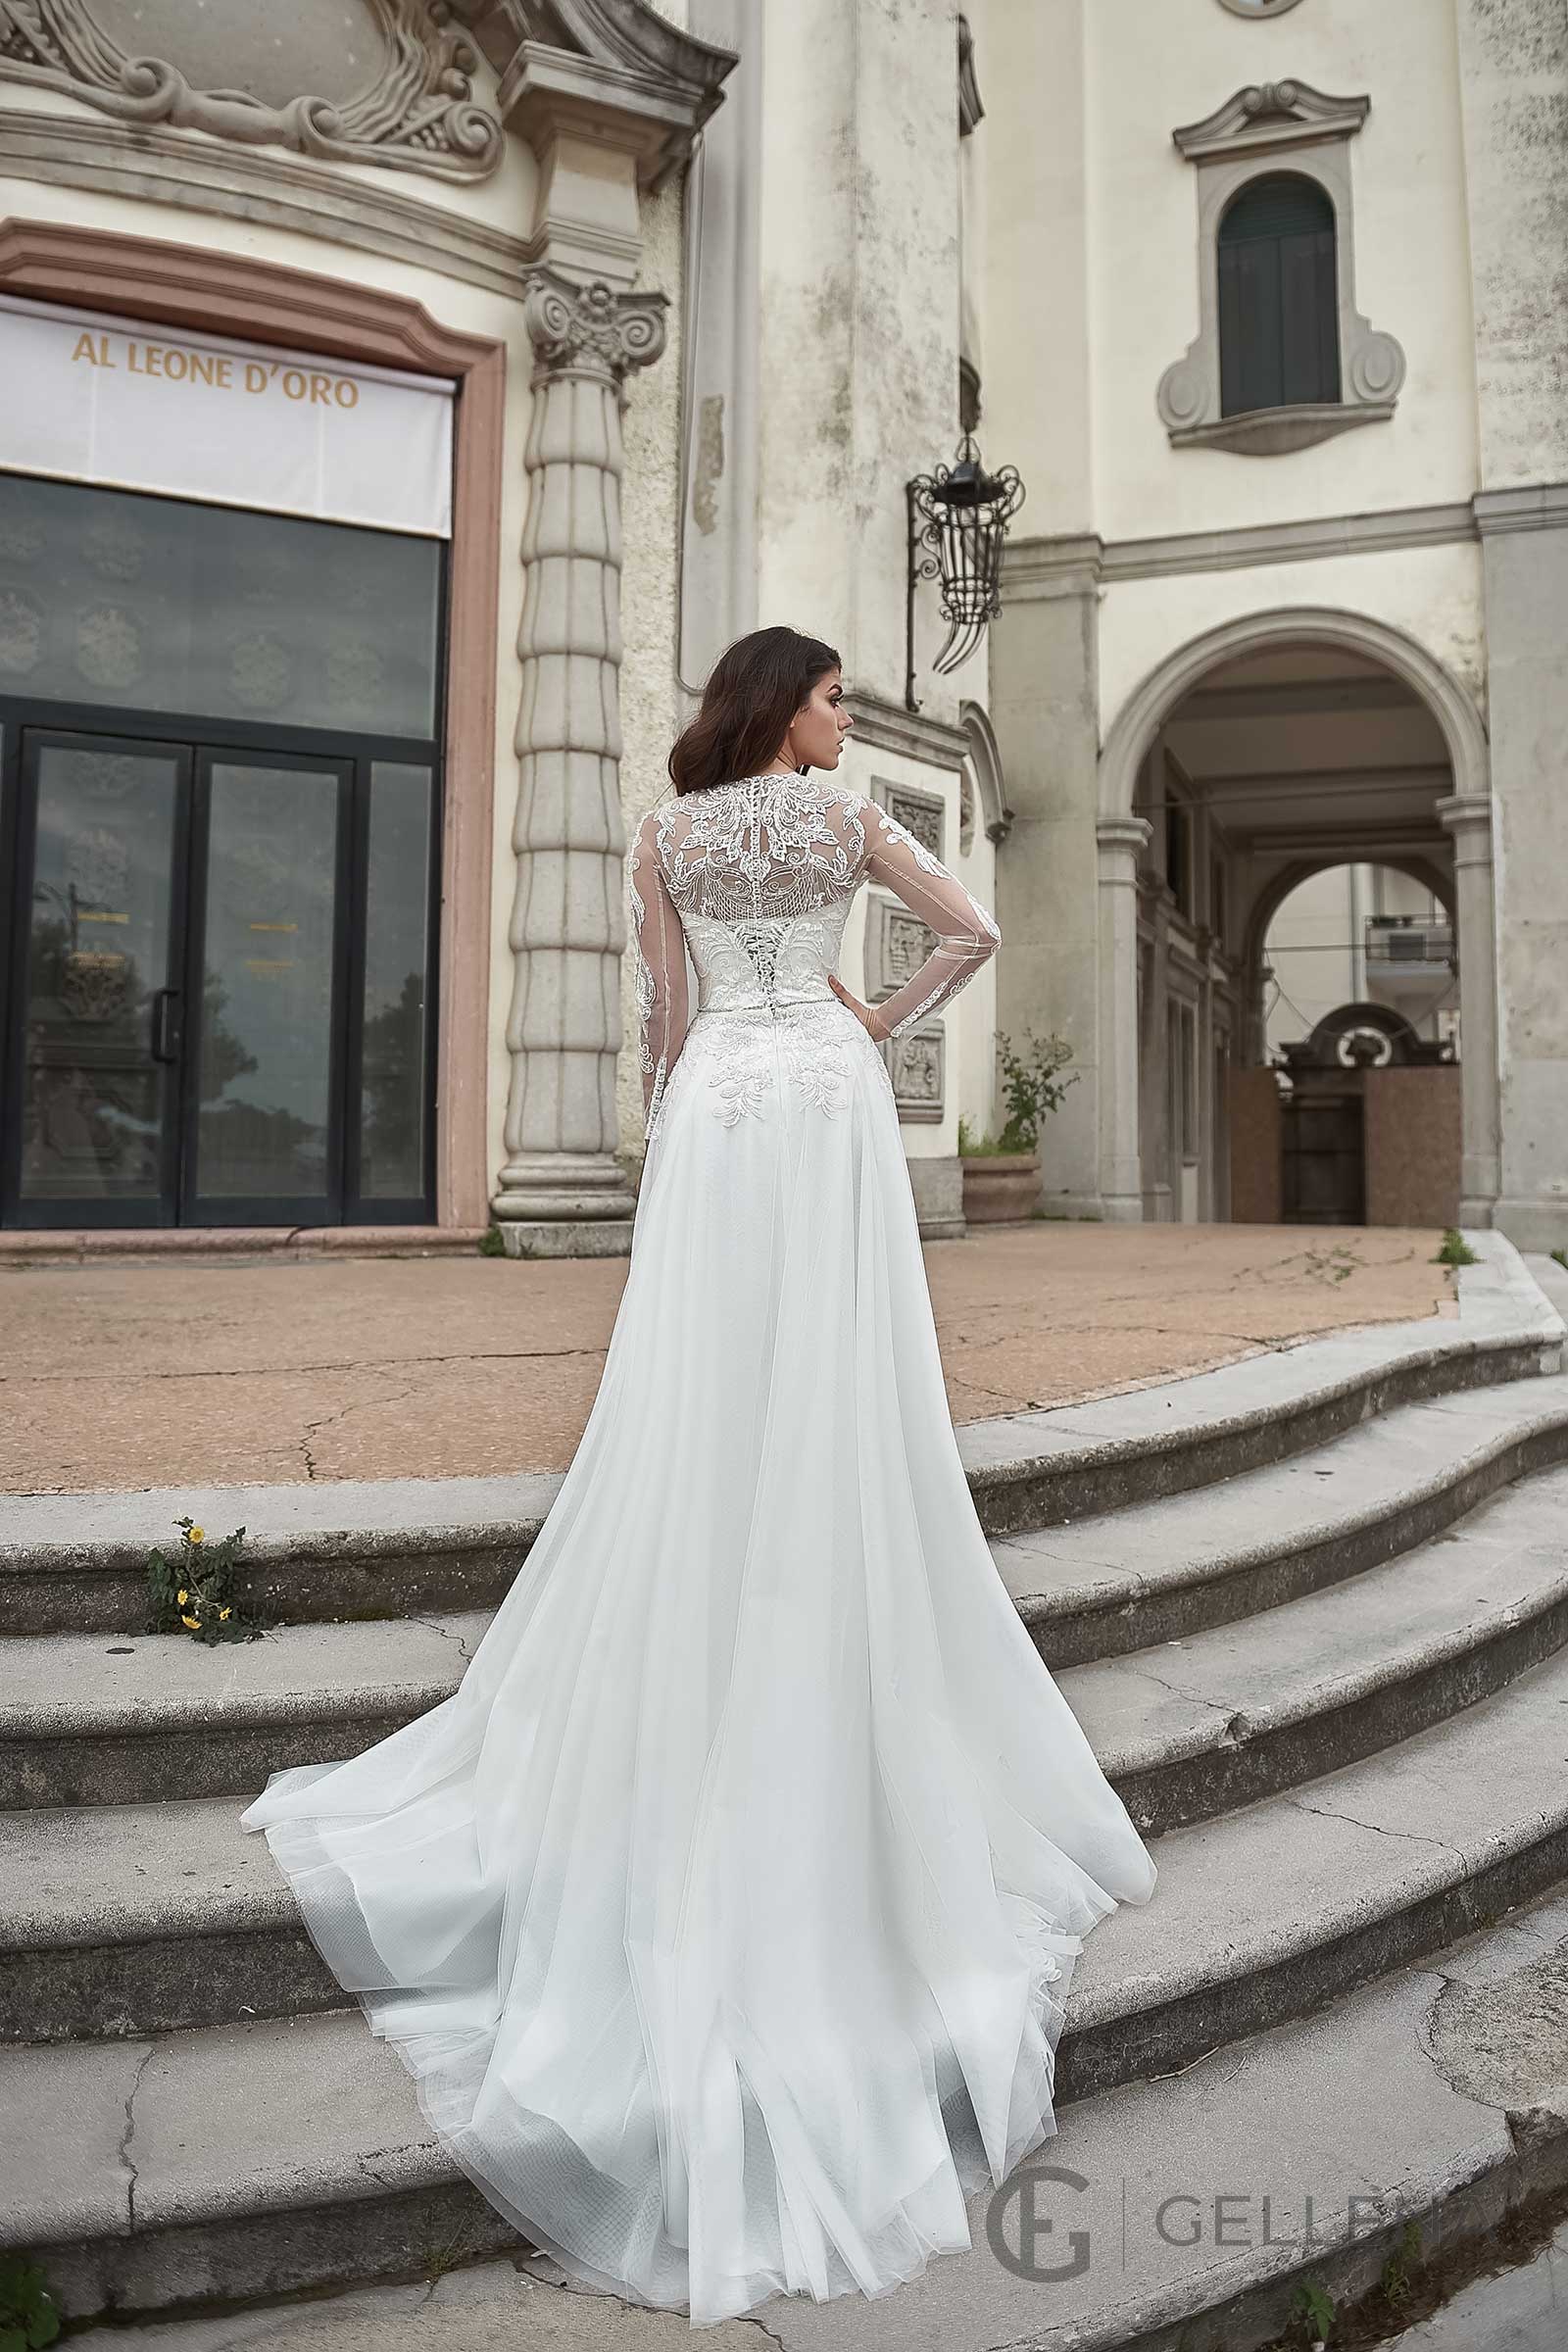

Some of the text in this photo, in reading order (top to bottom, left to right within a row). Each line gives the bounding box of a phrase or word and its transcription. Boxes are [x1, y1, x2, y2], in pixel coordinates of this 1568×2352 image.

[72, 333, 360, 409] AL LEONE D'ORO
